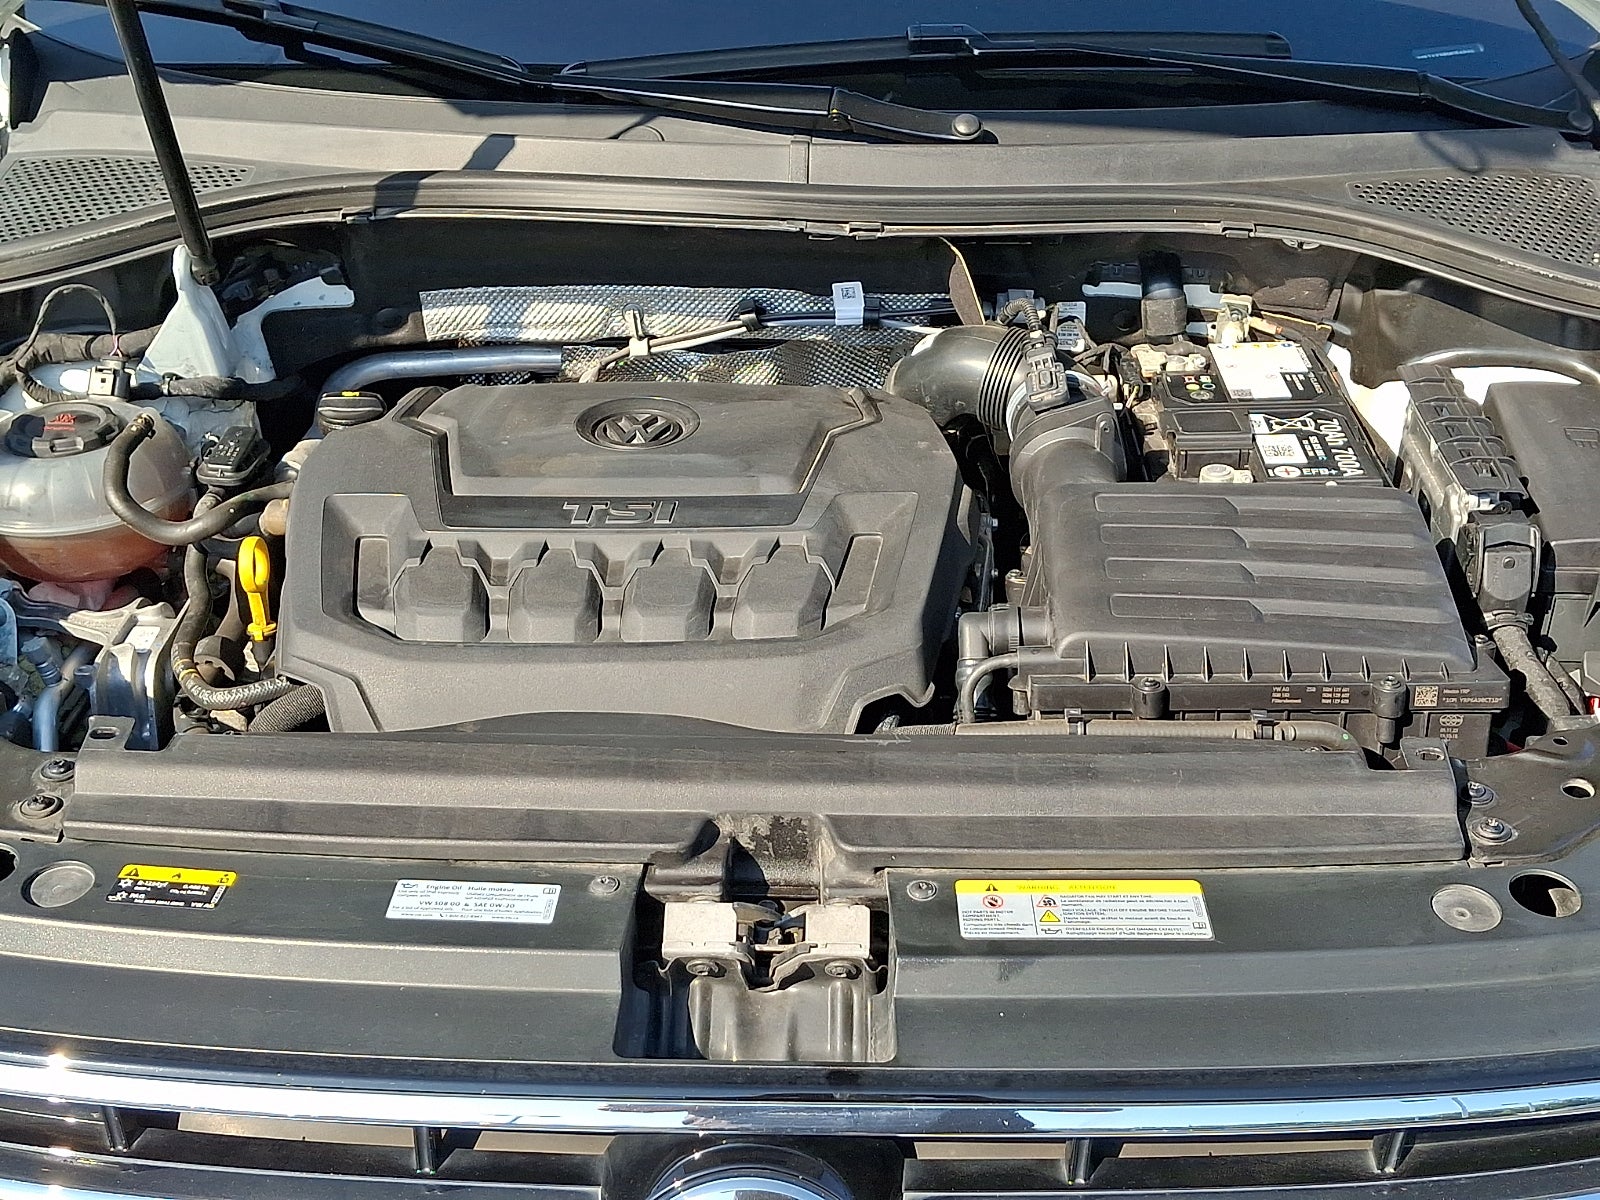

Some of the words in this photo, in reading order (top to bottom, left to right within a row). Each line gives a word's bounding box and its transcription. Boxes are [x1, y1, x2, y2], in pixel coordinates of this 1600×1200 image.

[1316, 418, 1348, 446] 70Ah
[1330, 448, 1364, 476] 700A
[562, 500, 680, 524] TSI
